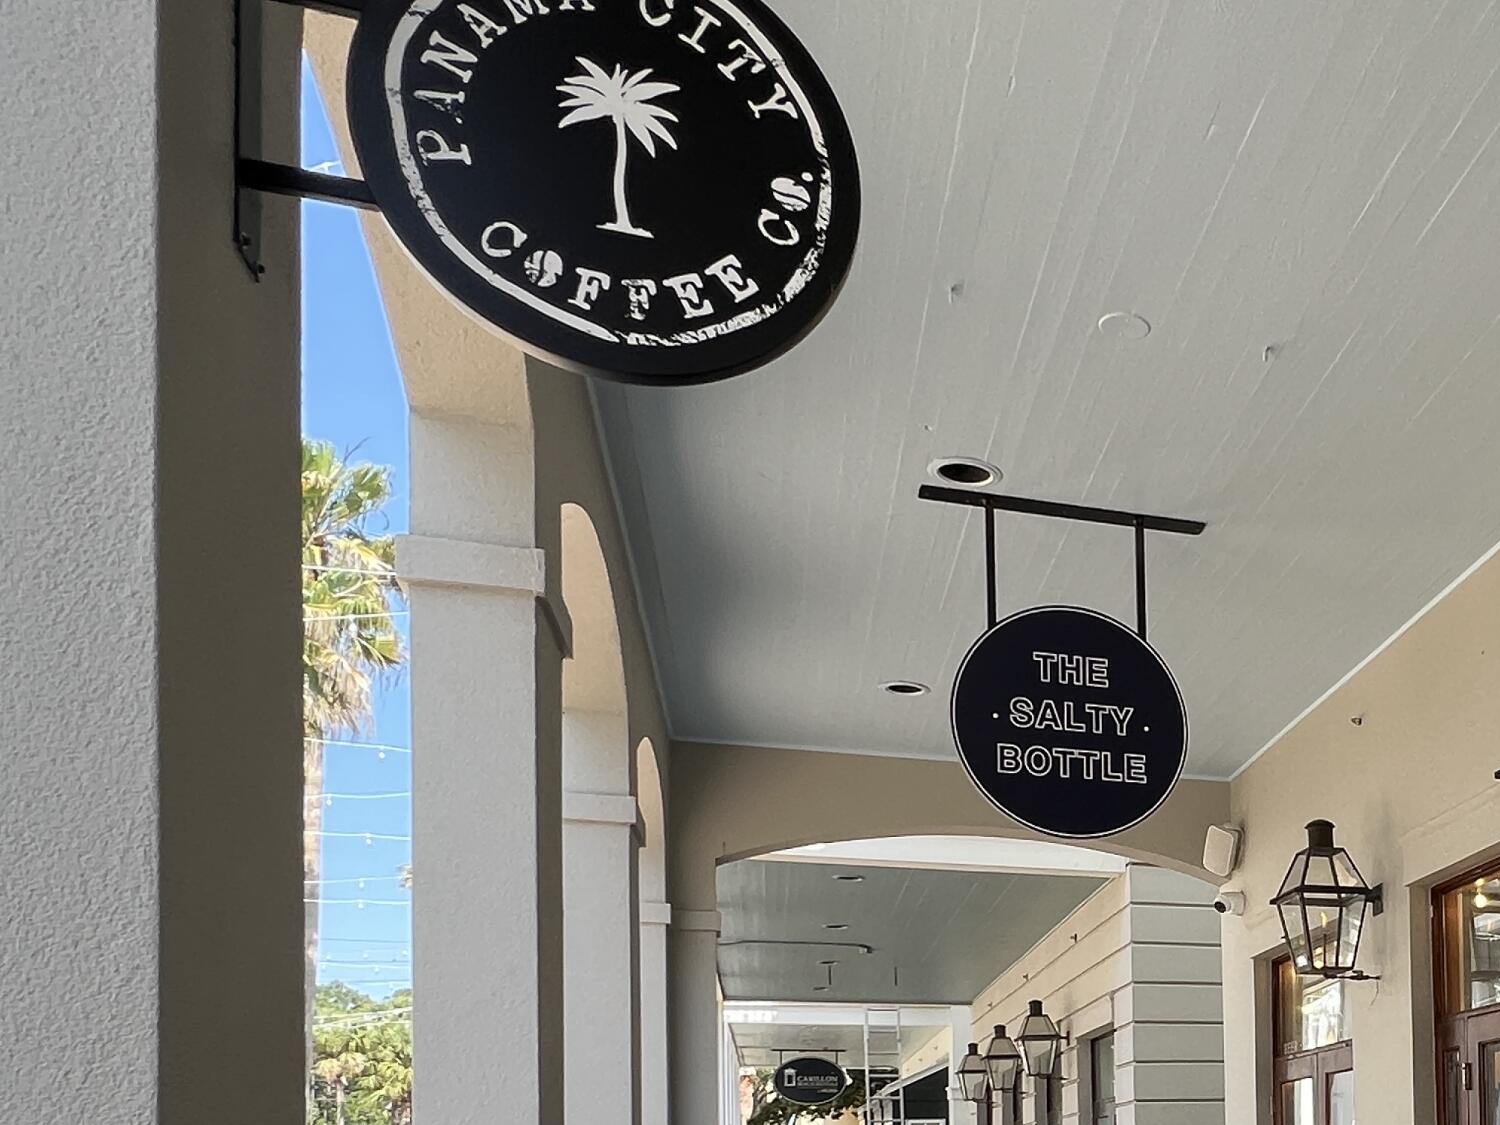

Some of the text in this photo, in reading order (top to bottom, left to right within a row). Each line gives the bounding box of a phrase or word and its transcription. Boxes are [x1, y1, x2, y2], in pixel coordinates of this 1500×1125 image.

[638, 0, 799, 121] CITY
[480, 221, 760, 321] COFFEE
[1033, 651, 1110, 688] THE
[1009, 696, 1134, 736] SALTY
[997, 742, 1148, 784] BOTTLE
